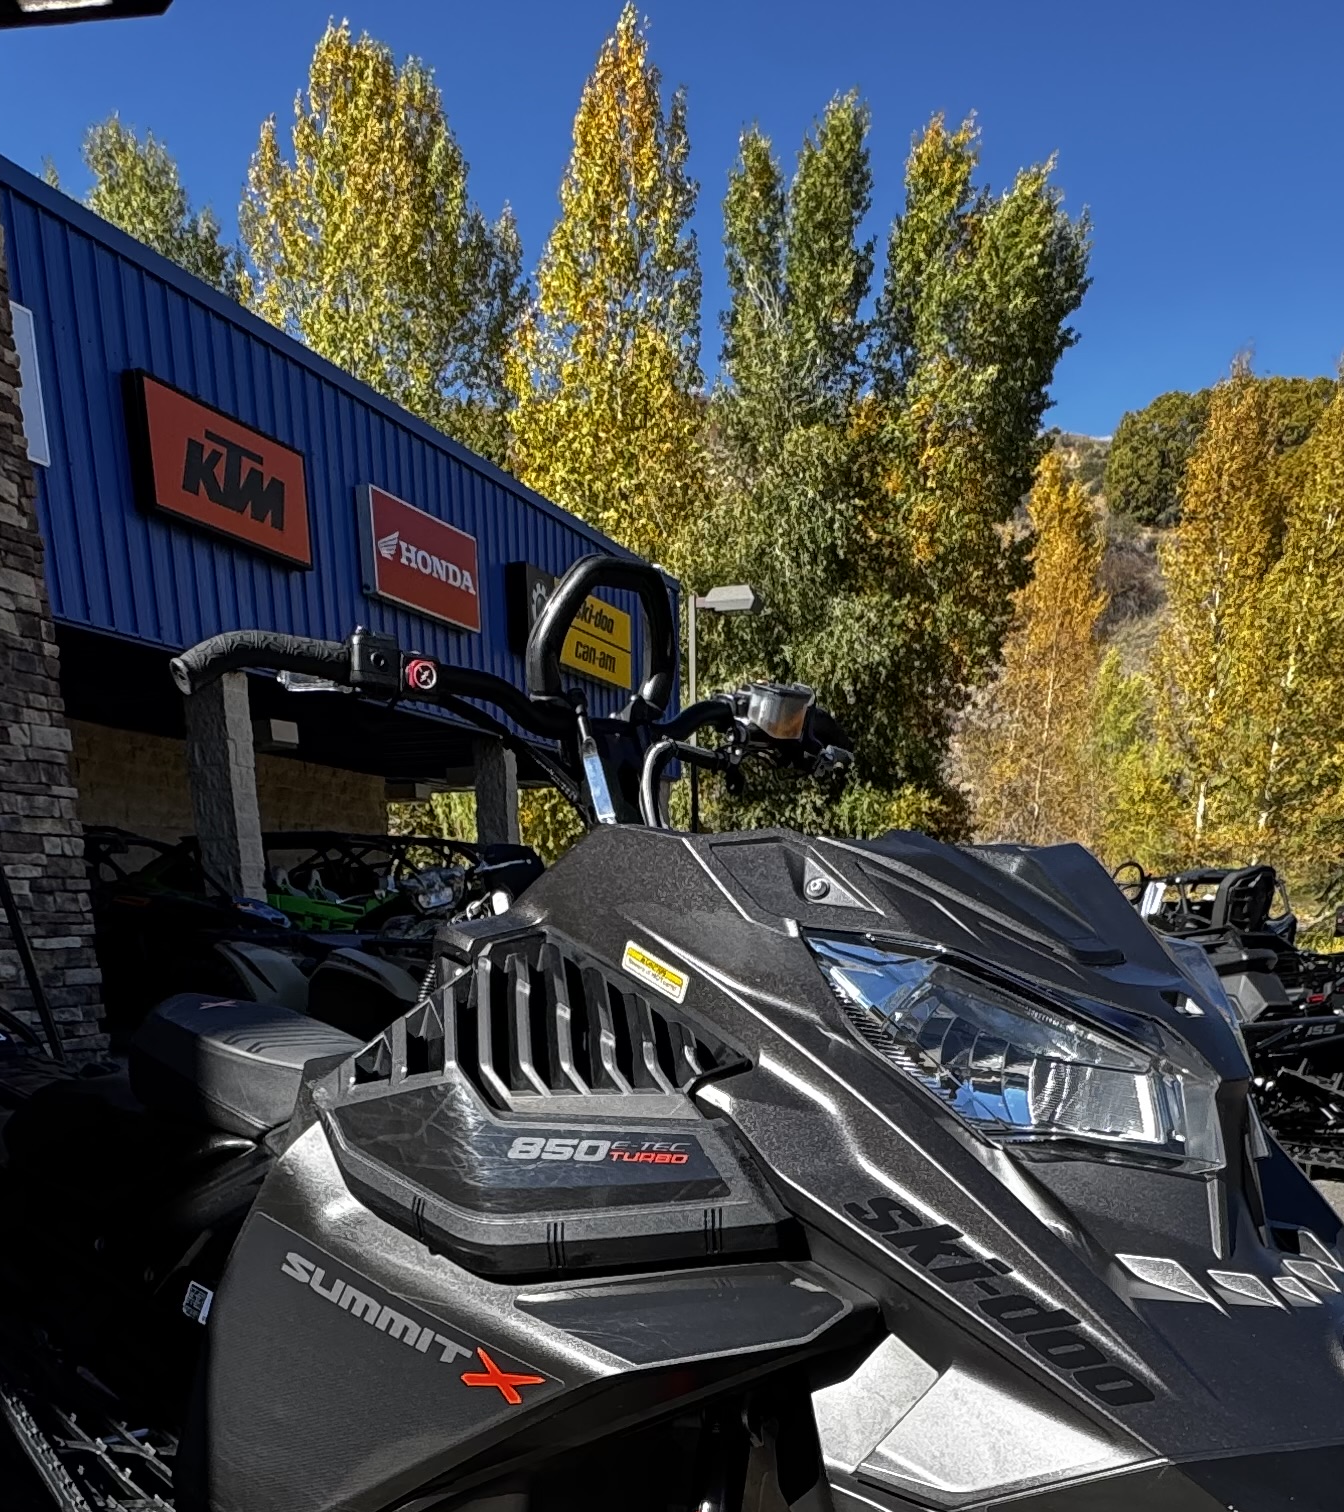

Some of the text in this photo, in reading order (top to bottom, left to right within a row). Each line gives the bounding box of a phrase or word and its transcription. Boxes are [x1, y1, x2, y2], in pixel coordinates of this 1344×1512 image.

[181, 429, 285, 531] KTM
[399, 540, 477, 595] HONDA
[575, 640, 616, 673] can-am
[507, 1137, 691, 1161] 850 E-TEC
[609, 1151, 689, 1165] TURBO
[280, 1251, 546, 1405] SUMMIT X
